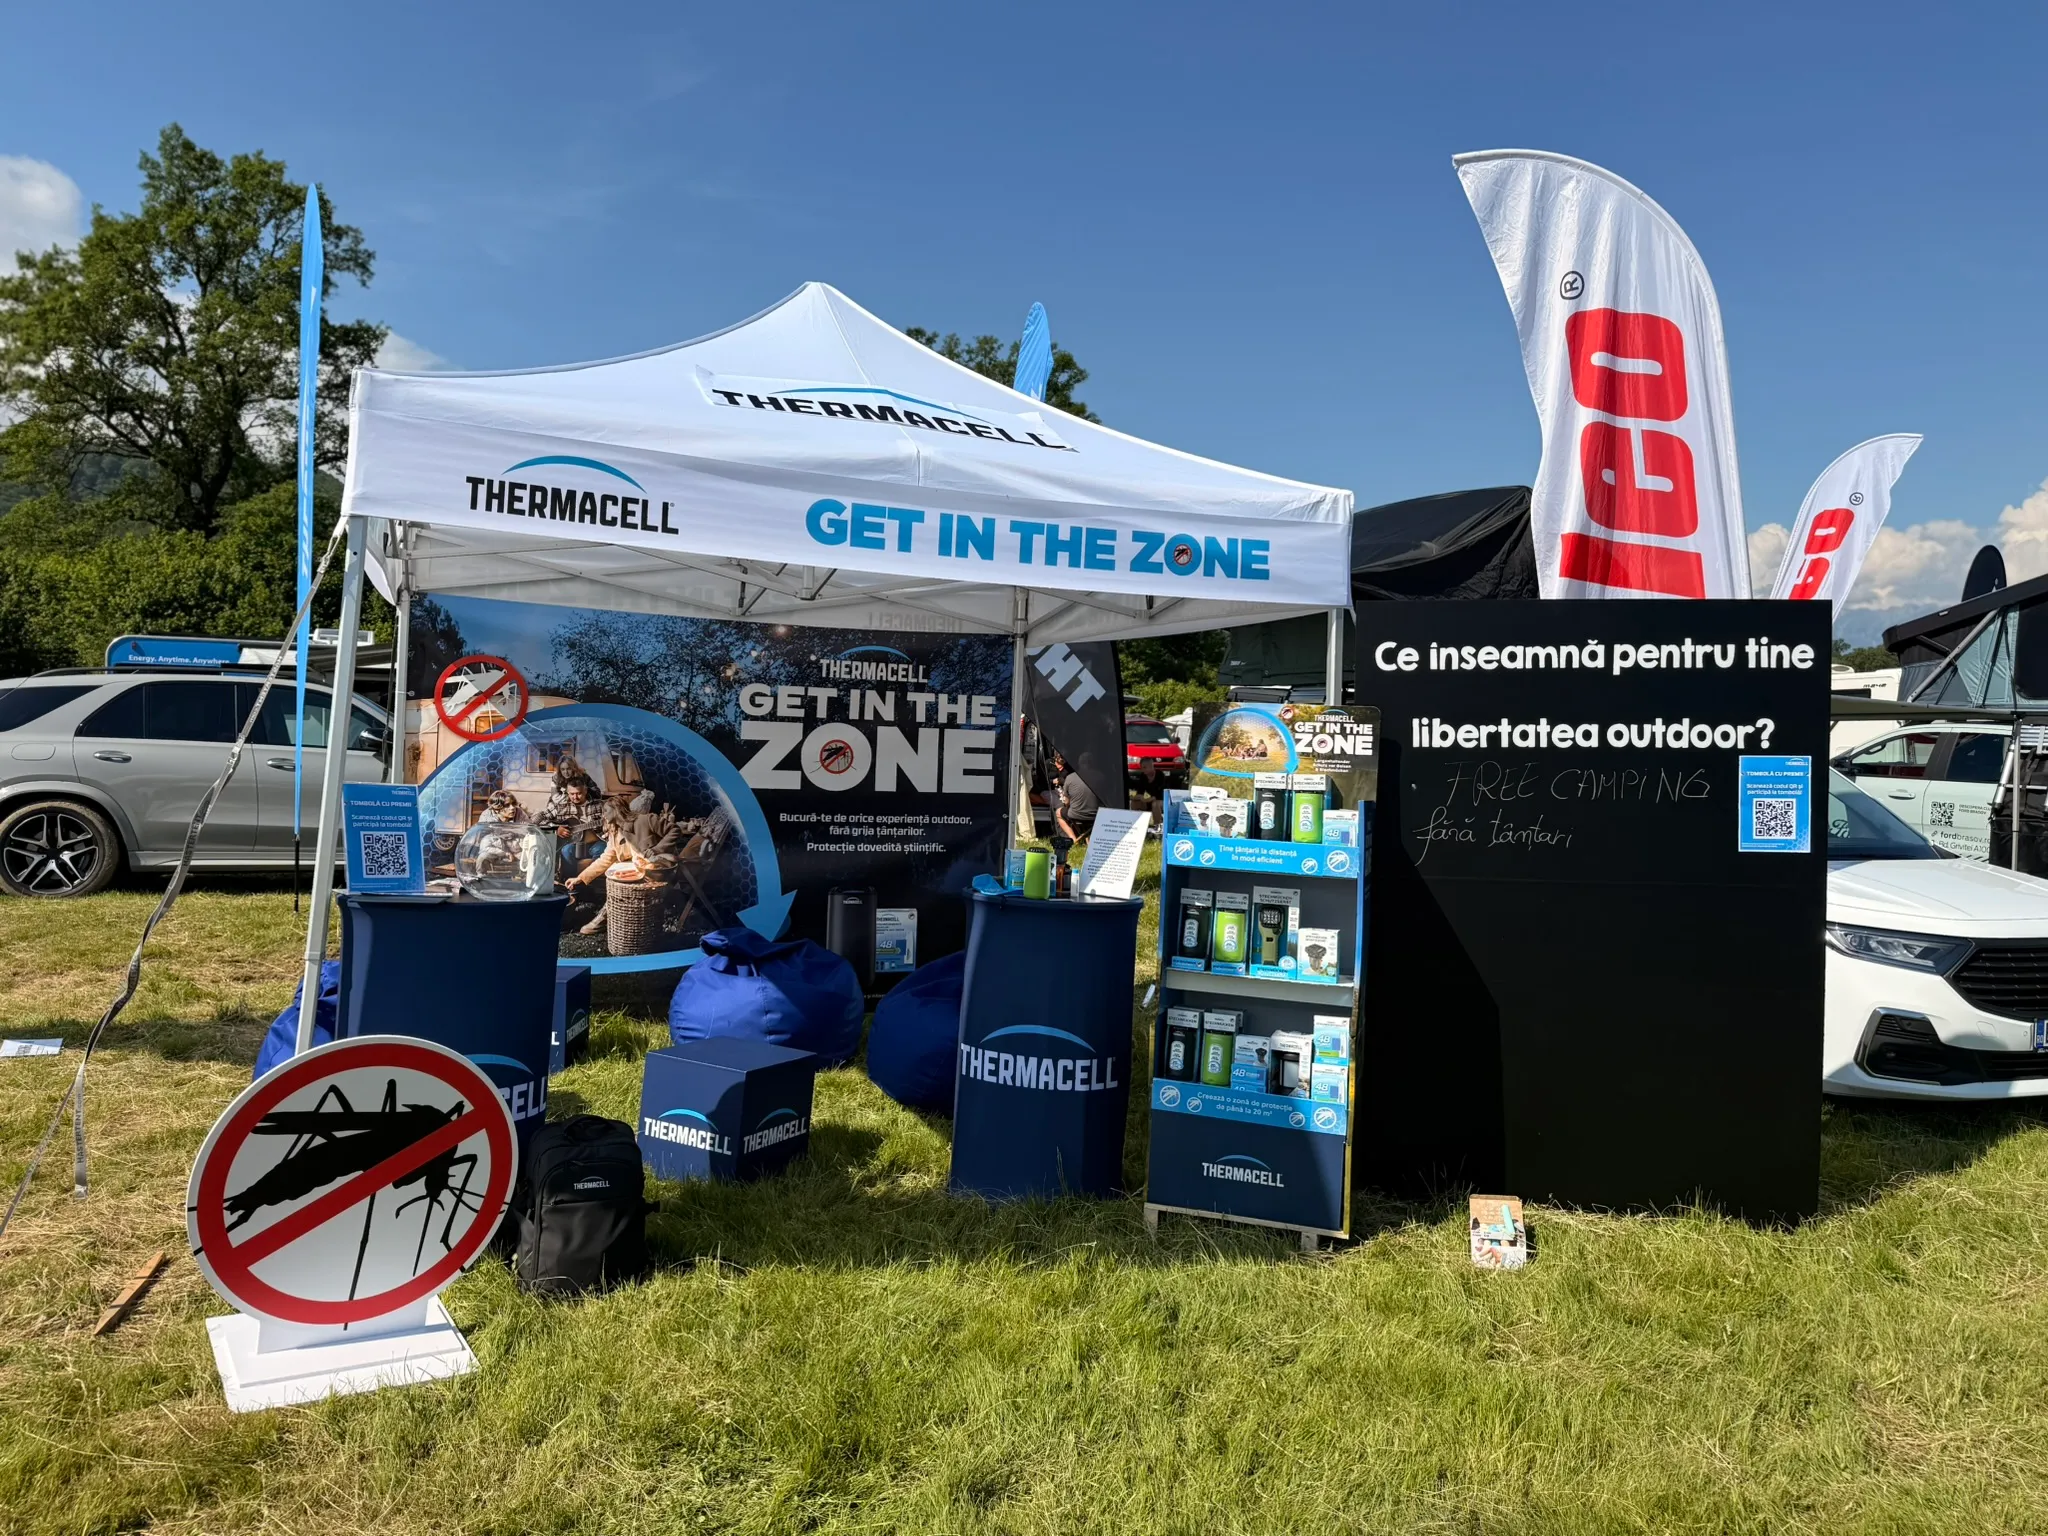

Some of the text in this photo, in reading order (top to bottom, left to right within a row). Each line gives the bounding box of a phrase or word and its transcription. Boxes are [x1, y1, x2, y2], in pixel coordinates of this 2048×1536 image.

[712, 388, 1068, 449] THERMACELL
[466, 476, 679, 535] THERMACELL
[805, 497, 1270, 581] GET IN THE ZONE
[128, 654, 157, 663] Energy.
[158, 656, 191, 664] Anytime.
[1375, 636, 1815, 676] Ce înseamnă pentru tine
[820, 658, 928, 684] THERMACELL
[738, 683, 997, 725] GET IN THE
[1294, 721, 1373, 735] GET IN THE
[1412, 718, 1776, 749] libertatea outdoor?
[740, 721, 997, 794] ZONE
[1295, 733, 1373, 756] ZONE
[1445, 761, 1539, 807] FREE
[779, 812, 832, 823] Bucură-te
[834, 813, 847, 823] de
[849, 813, 874, 823] orice
[932, 814, 973, 826] outdoor,
[829, 825, 850, 835] fără
[852, 826, 875, 837] grija
[807, 842, 855, 855] Protecție
[857, 842, 902, 852] dovedită
[880, 940, 893, 949] 48
[1317, 1034, 1331, 1043] 48
[960, 1042, 1118, 1092] THERMACELL
[1232, 1068, 1246, 1077] 48
[1315, 1082, 1329, 1092] 48
[644, 1116, 732, 1156] THERMACELL
[743, 1117, 807, 1154] THERMACELL
[573, 1179, 611, 1190] THERMACELL
[1201, 1161, 1285, 1188] THERMACELL
